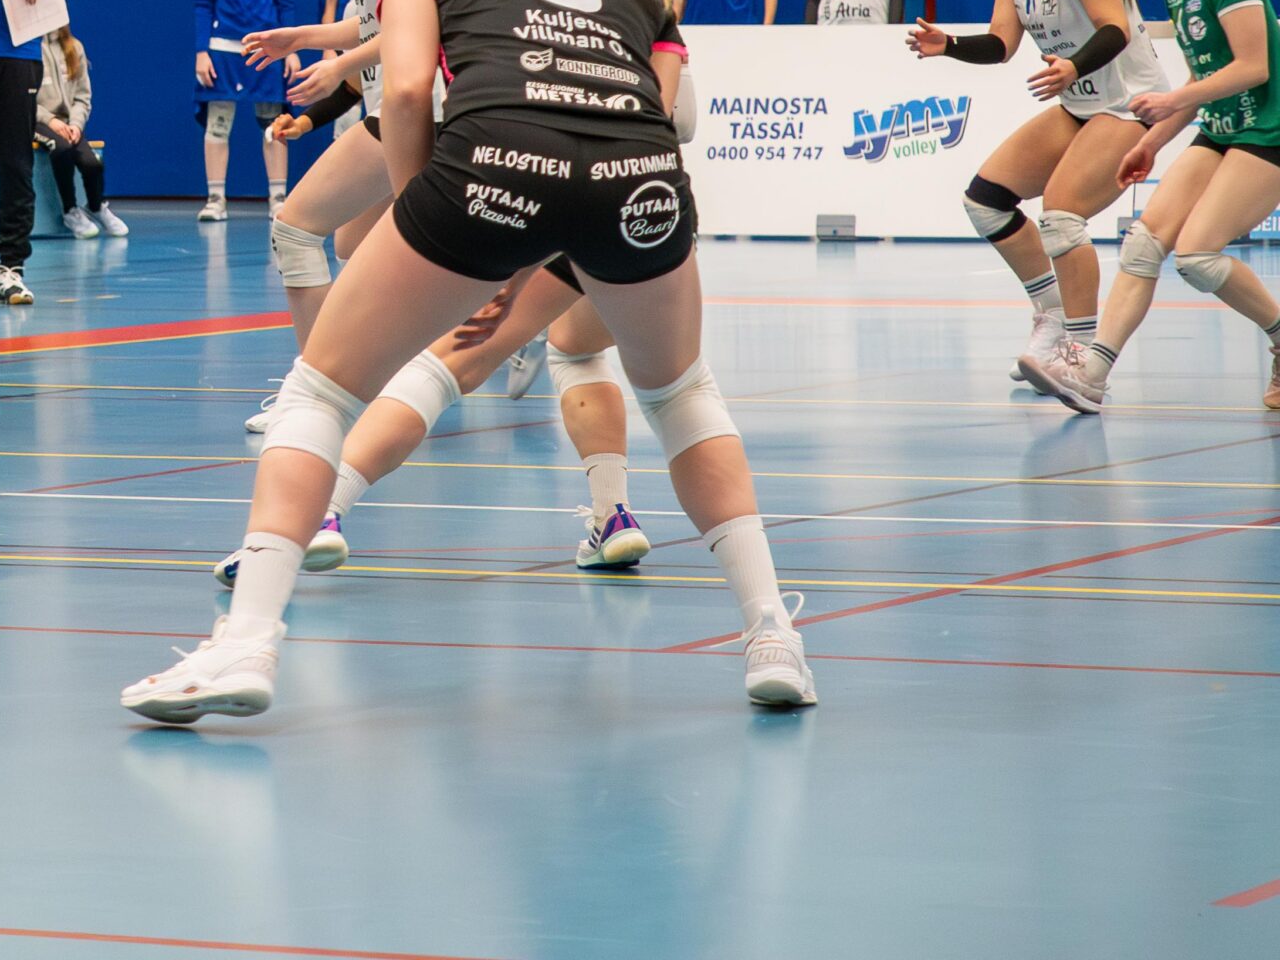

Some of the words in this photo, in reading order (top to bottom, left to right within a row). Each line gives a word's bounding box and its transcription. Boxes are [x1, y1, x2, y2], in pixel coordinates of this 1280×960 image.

[835, 2, 871, 18] Atria
[526, 8, 622, 40] Kuljetus
[513, 24, 606, 50] Villman
[555, 57, 641, 85] KONNEGROUP
[1067, 78, 1099, 96] ria
[709, 97, 828, 115] MAINOSTA
[729, 117, 804, 140] TÄSSÄ!
[706, 146, 749, 161] 0400
[755, 146, 787, 161] 954
[793, 146, 824, 161] 747
[893, 140, 938, 159] volley
[472, 145, 571, 180] NELOSTIEN
[590, 152, 678, 181] SUURIMMAT
[465, 183, 542, 217] PUTAAN
[620, 196, 680, 221] PUTAAN
[467, 199, 528, 230] Pizzeria
[628, 217, 674, 239] Baari
